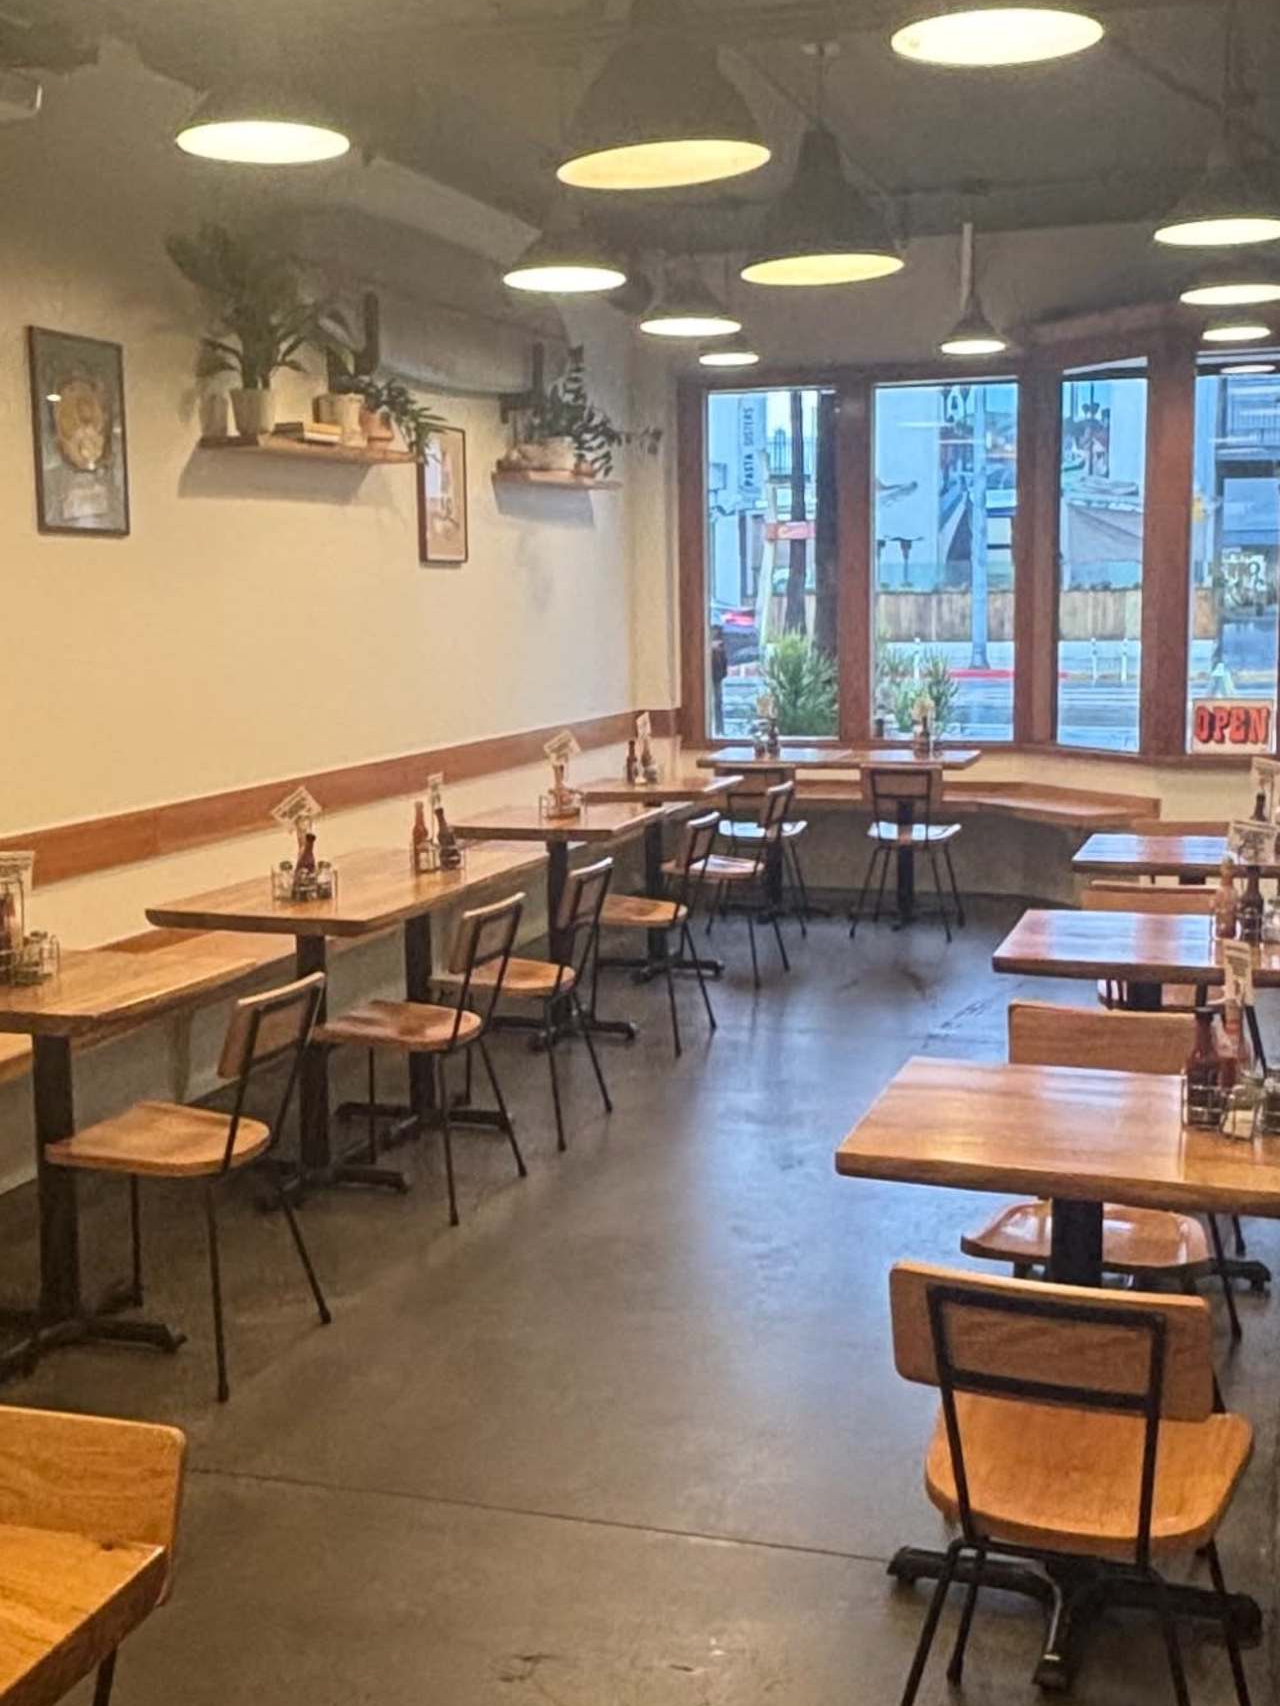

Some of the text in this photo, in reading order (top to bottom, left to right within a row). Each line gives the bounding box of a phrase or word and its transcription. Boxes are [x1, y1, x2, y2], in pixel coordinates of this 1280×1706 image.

[743, 407, 755, 487] PASTA SISTERS
[1195, 705, 1271, 745] OPEN
